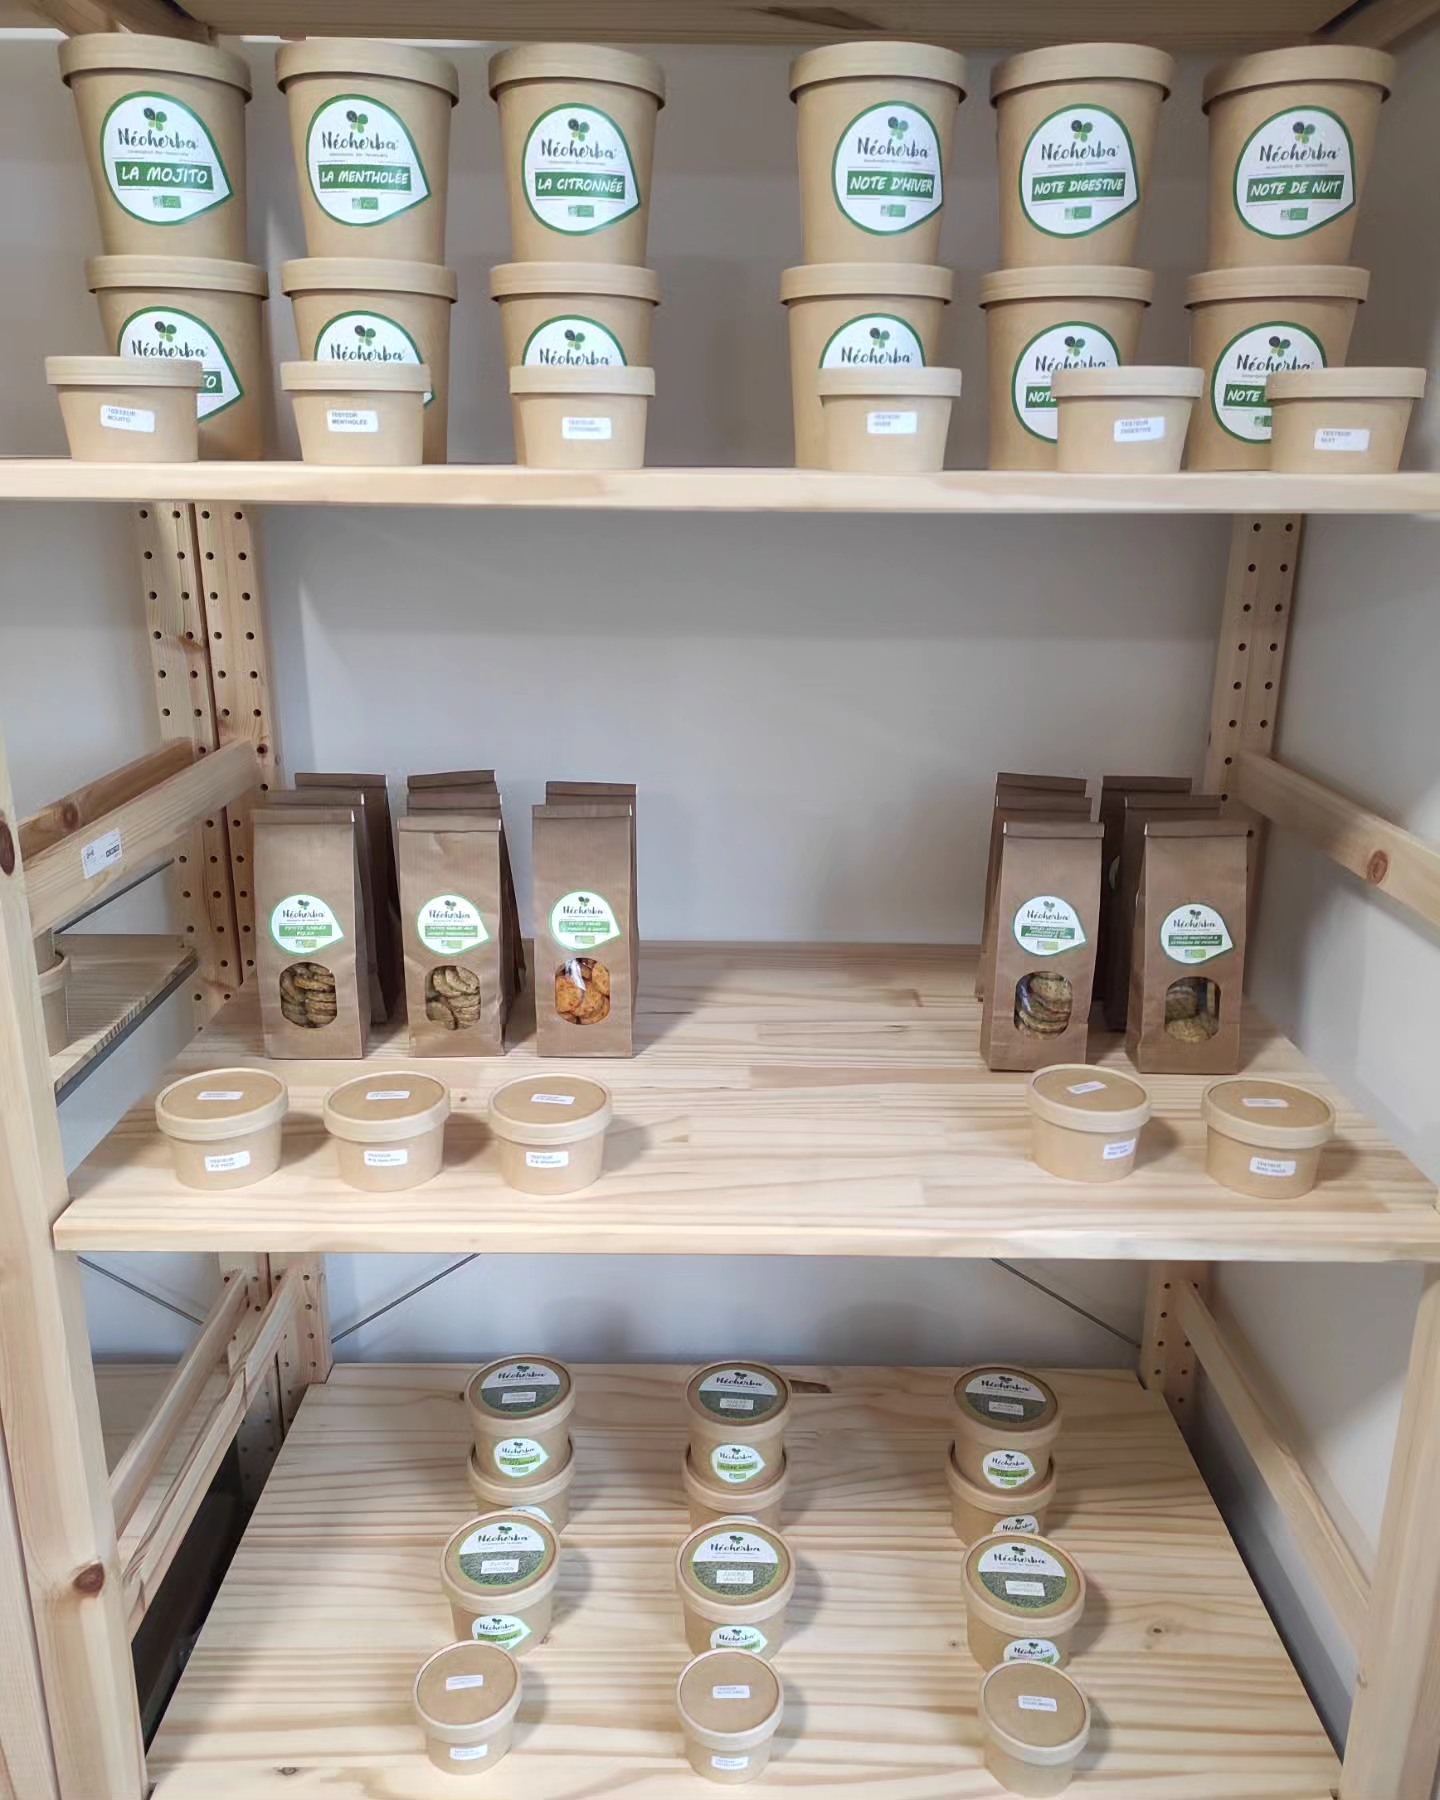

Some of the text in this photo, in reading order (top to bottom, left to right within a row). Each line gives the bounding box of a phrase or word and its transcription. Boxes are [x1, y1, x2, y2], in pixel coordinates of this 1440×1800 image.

[117, 127, 198, 150] Néoherba
[321, 130, 398, 151] Néoherba
[540, 138, 616, 159] Néoherba
[857, 137, 929, 159] Néoherba
[1041, 141, 1118, 160] Néoherba
[1259, 143, 1338, 162] Néoherba
[121, 166, 209, 184] LA MOJITO
[321, 170, 409, 185] LA MENTHOLÉE
[850, 175, 933, 193] NOTE D'HIVER
[537, 178, 624, 193] LA CITRONNÉE
[1034, 178, 1124, 196] NOTE DIGESTIVE
[1251, 179, 1342, 196] NOTE DE NUIT
[131, 339, 206, 358] Néoherba
[330, 344, 404, 362] Néoherba
[539, 348, 610, 366] Néoherba
[841, 347, 912, 364] Néoherba
[1236, 354, 1310, 371] Néoherba
[1227, 388, 1261, 401] NOTE
